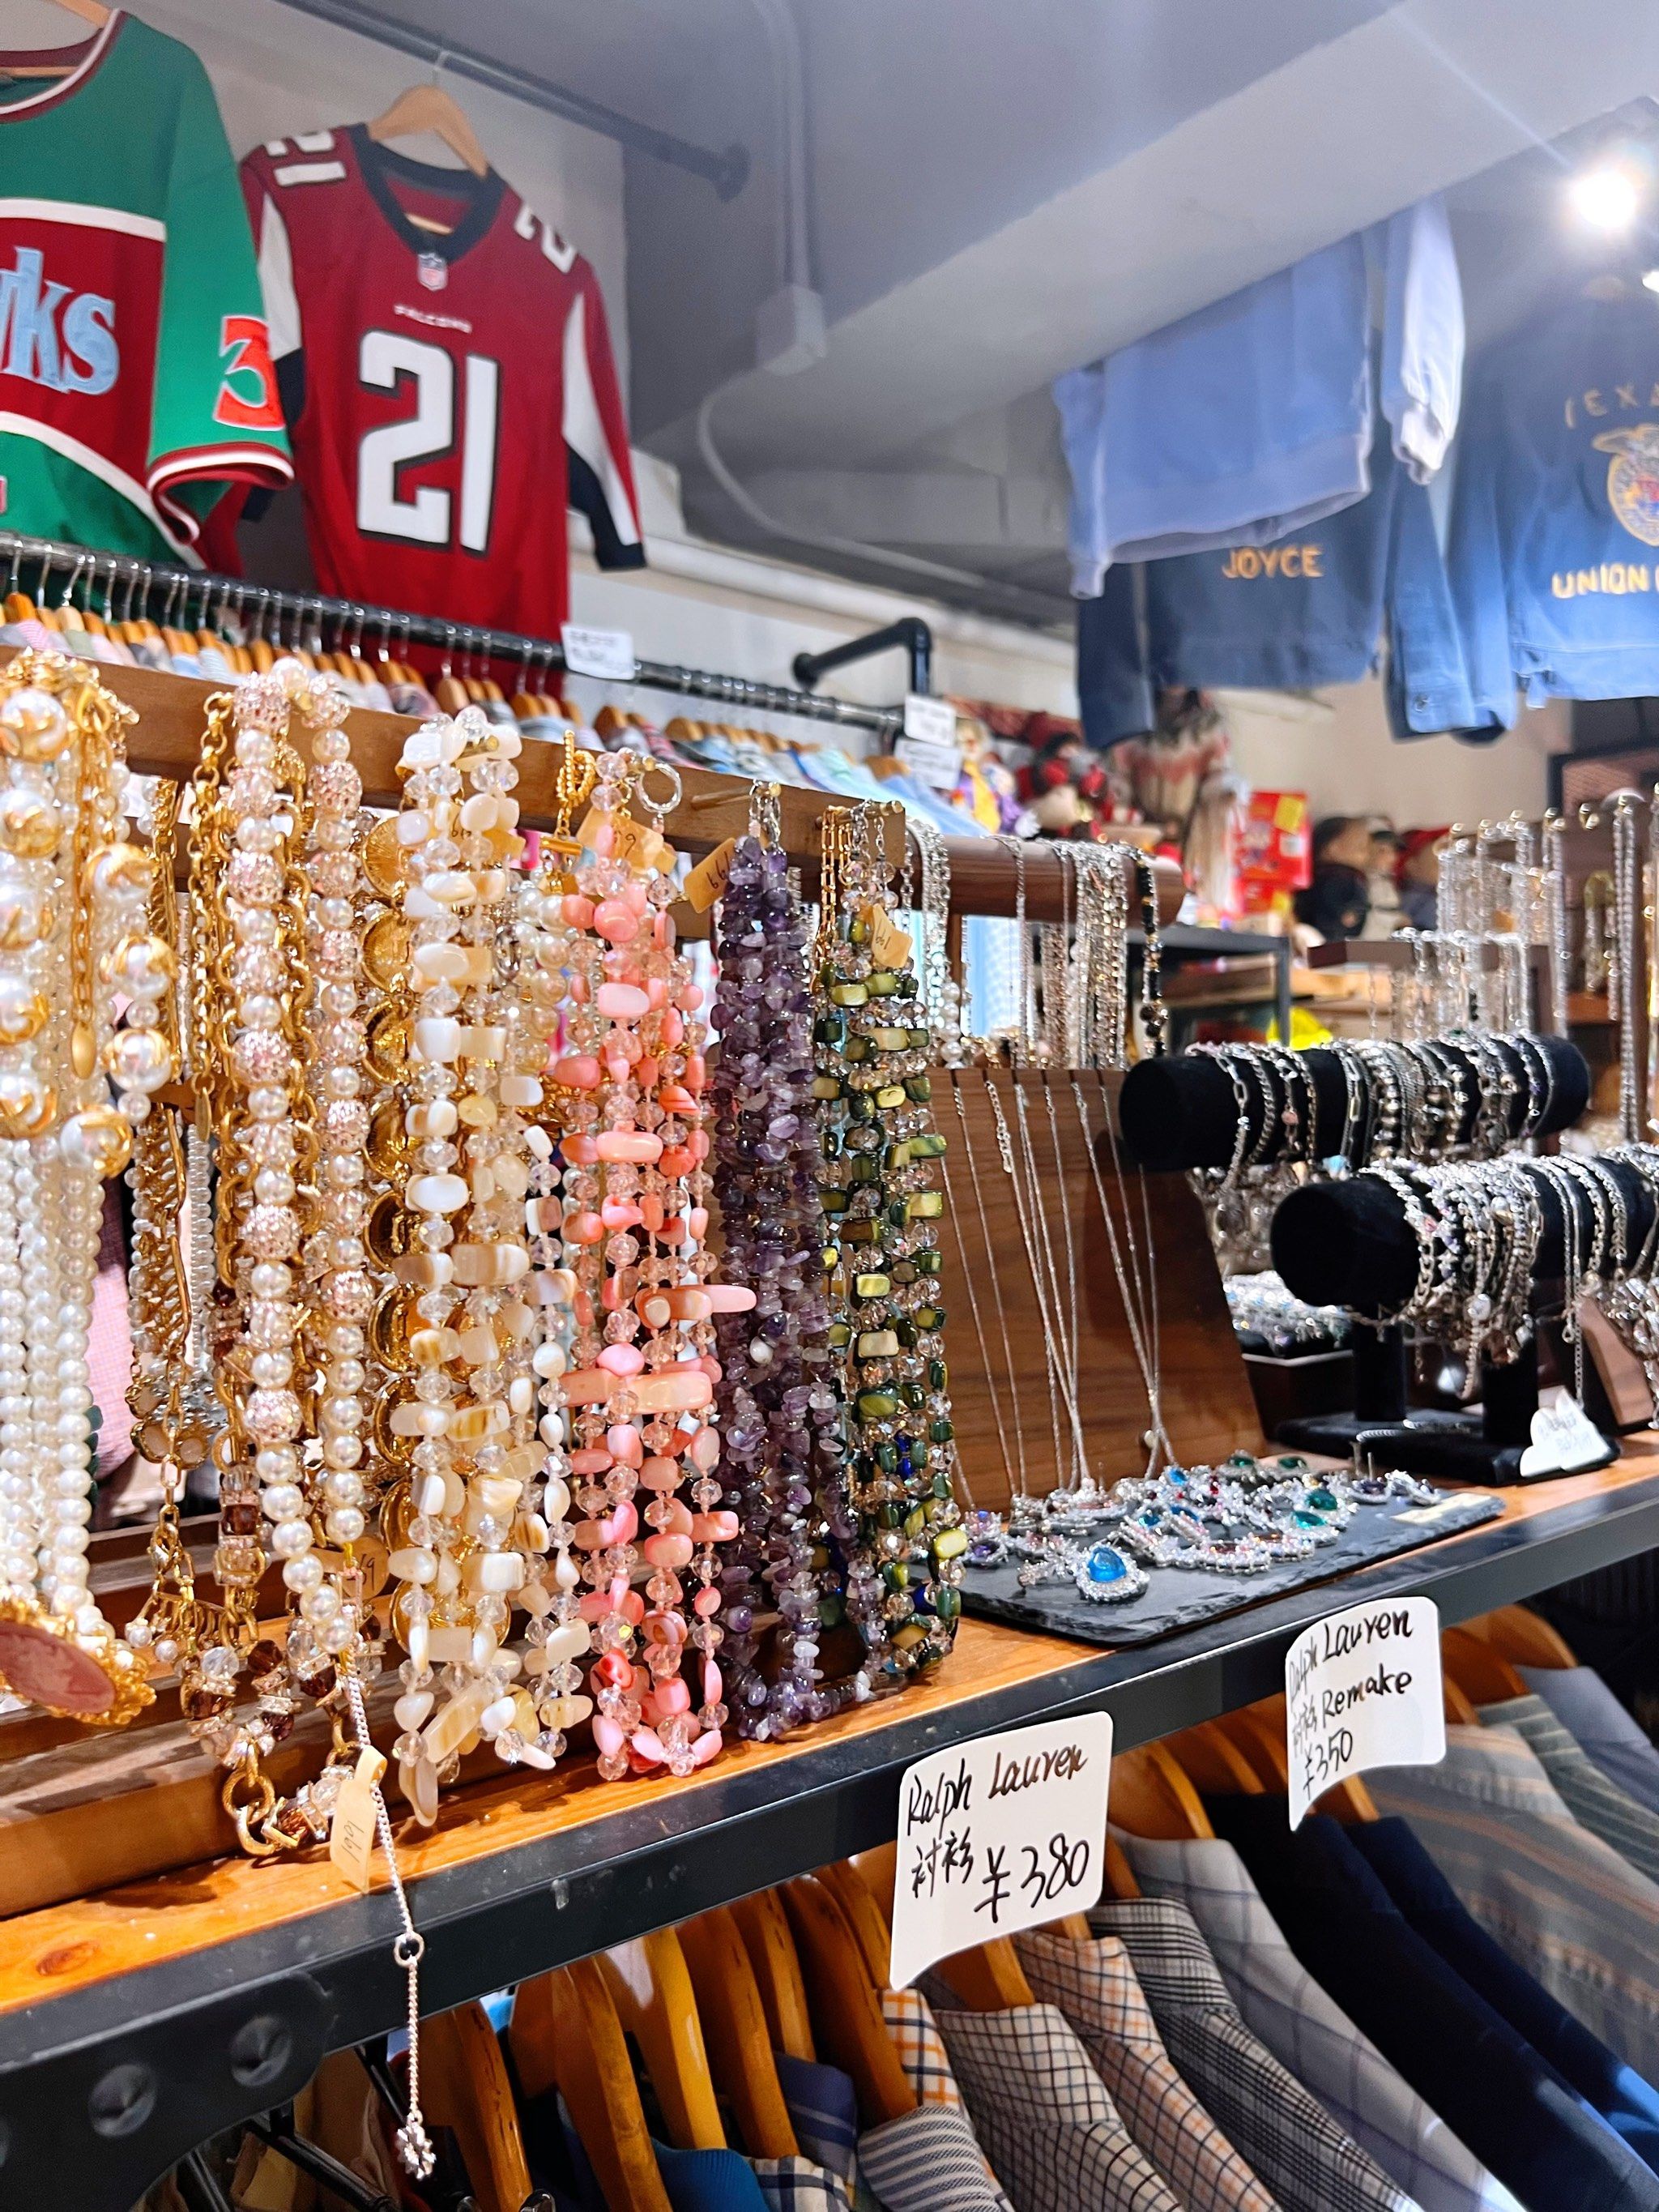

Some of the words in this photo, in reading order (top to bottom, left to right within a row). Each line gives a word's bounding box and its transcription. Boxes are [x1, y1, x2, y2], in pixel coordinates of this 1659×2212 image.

[357, 329, 499, 559] 21
[1222, 544, 1324, 579] JOYCE
[1551, 562, 1650, 599] UNION
[1323, 1610, 1413, 1662] Lauren
[1323, 1663, 1412, 1729] Remake
[907, 1757, 972, 1840] Ralph
[988, 1744, 1089, 1799] Lauren
